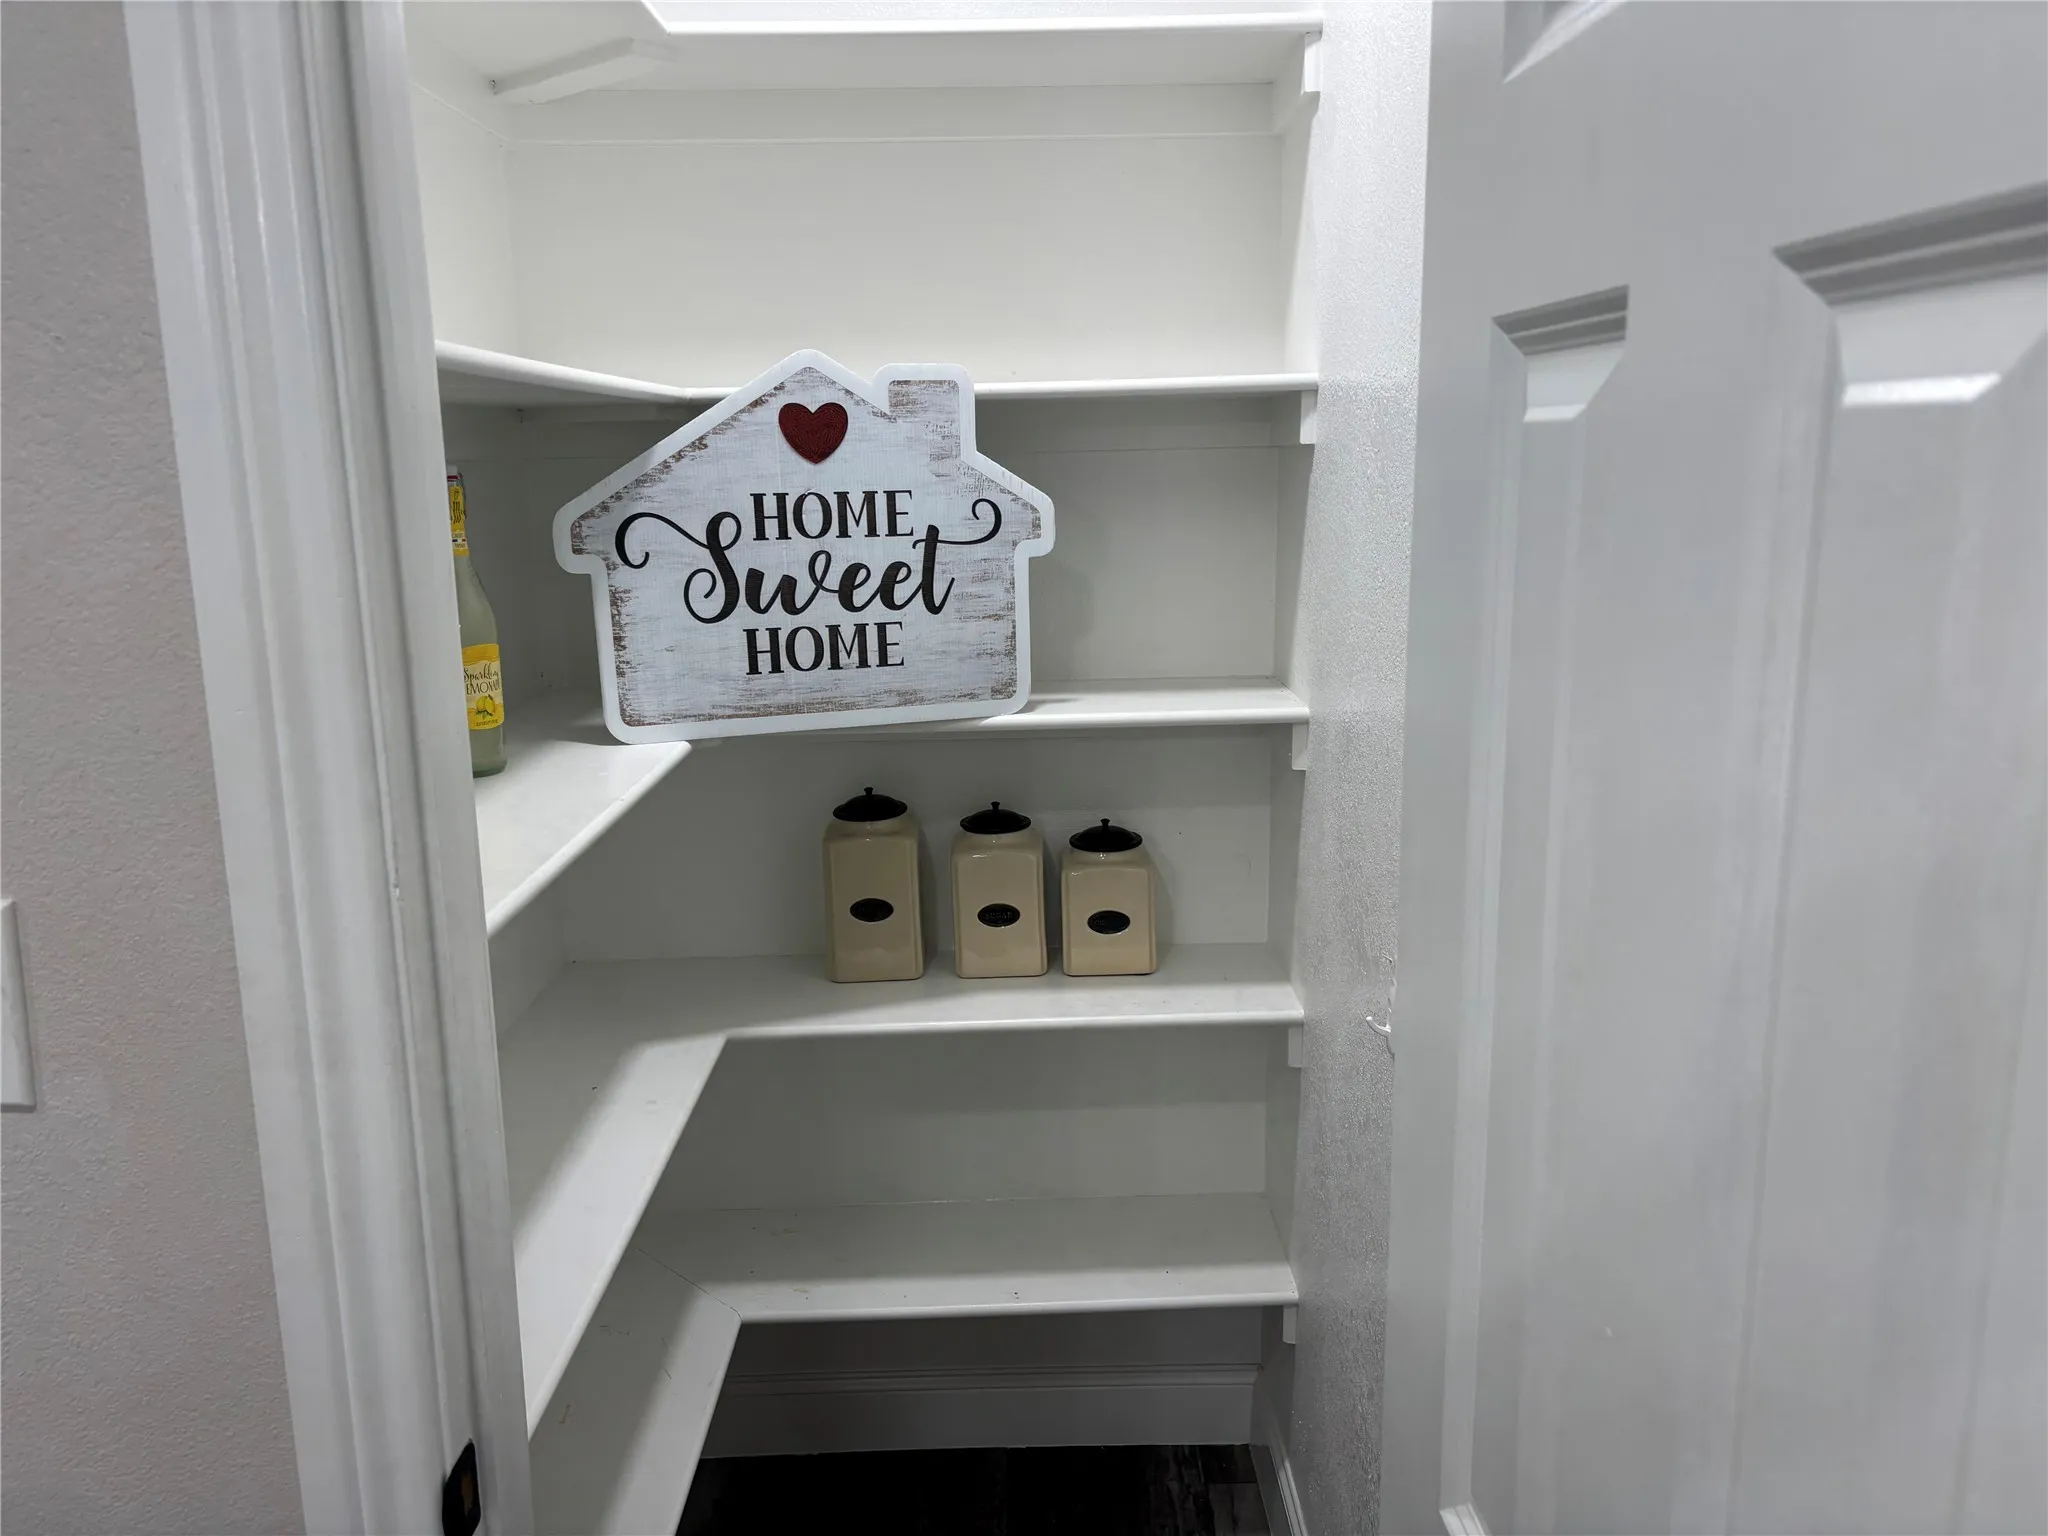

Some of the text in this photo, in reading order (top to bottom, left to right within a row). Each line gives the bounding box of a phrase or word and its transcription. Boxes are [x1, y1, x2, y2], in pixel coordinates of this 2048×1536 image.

[749, 489, 914, 541] HOME
[614, 497, 1002, 624] Sweet
[742, 620, 905, 675] HOME
[465, 678, 502, 695] EMONAD
